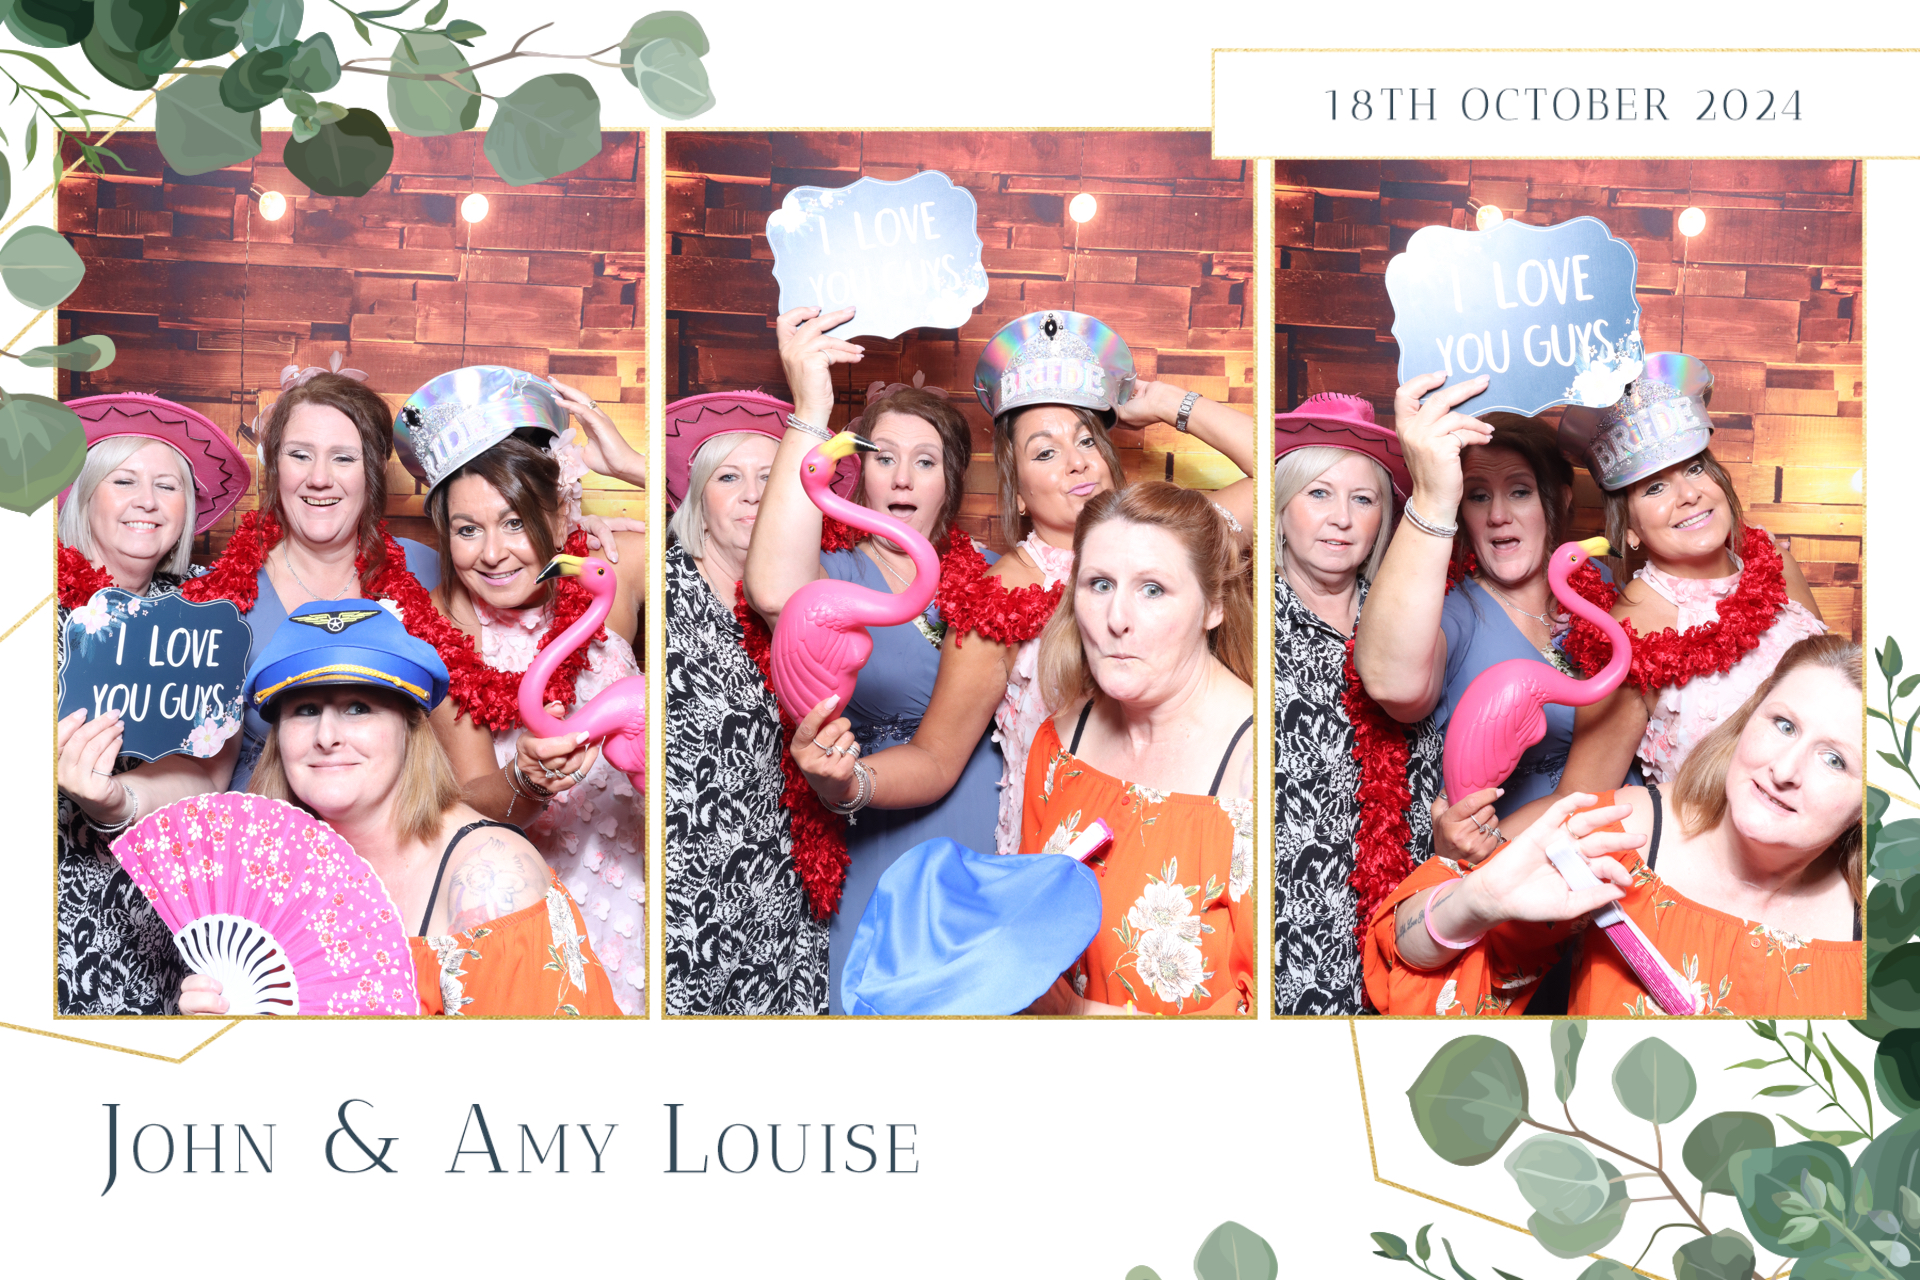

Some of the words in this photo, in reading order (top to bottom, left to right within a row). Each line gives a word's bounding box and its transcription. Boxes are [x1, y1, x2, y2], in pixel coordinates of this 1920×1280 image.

[818, 215, 831, 256] I
[853, 201, 941, 250] LOVE
[808, 263, 874, 309] YOU
[882, 253, 962, 296] GUYS
[1451, 263, 1463, 314] I
[1492, 254, 1595, 310] LOVE
[1435, 329, 1511, 377] YOU
[1522, 318, 1615, 368] GUYS
[1000, 357, 1106, 403] BRIDE
[1591, 396, 1701, 474] BRIDE
[115, 621, 127, 666] I
[149, 624, 223, 669] LOVE
[93, 682, 151, 722] YOU
[159, 682, 225, 721] GUYS
